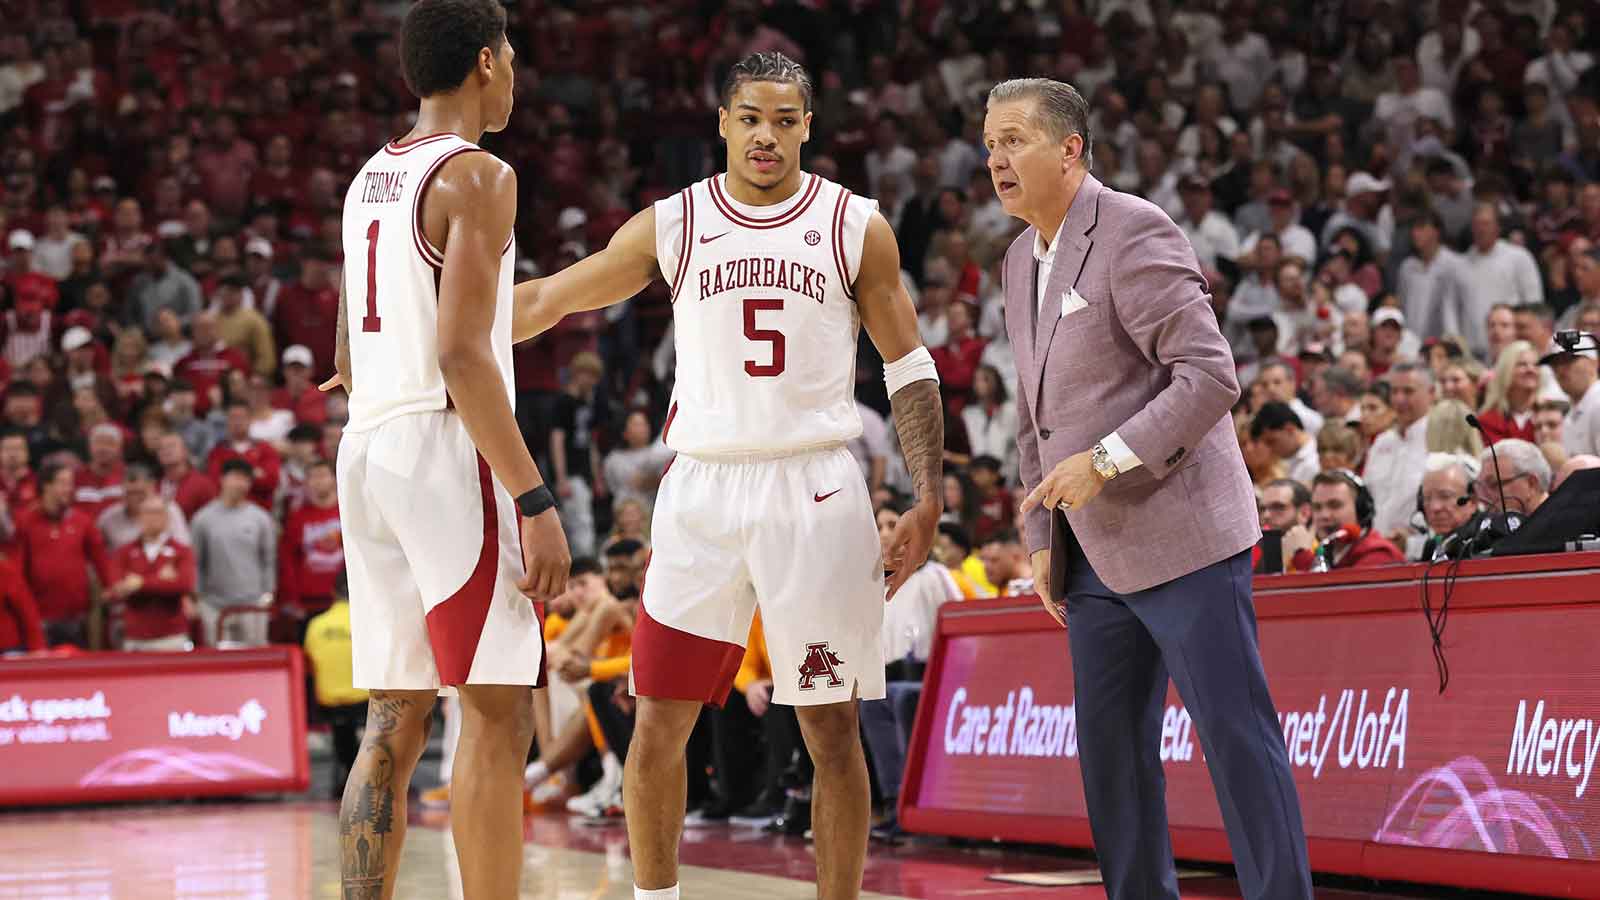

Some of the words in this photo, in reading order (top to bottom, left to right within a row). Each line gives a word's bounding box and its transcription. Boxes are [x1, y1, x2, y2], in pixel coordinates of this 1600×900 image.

[362, 171, 407, 203] THOMAS
[362, 219, 381, 332] 1
[699, 257, 826, 304] RAZORBACKS
[743, 299, 785, 377] 5
[168, 711, 244, 741] Mercy
[944, 687, 990, 755] Care
[988, 690, 1015, 755] at
[1160, 705, 1193, 762] ed.
[1277, 687, 1409, 779] net/UofA
[1506, 699, 1600, 798] Mercy
